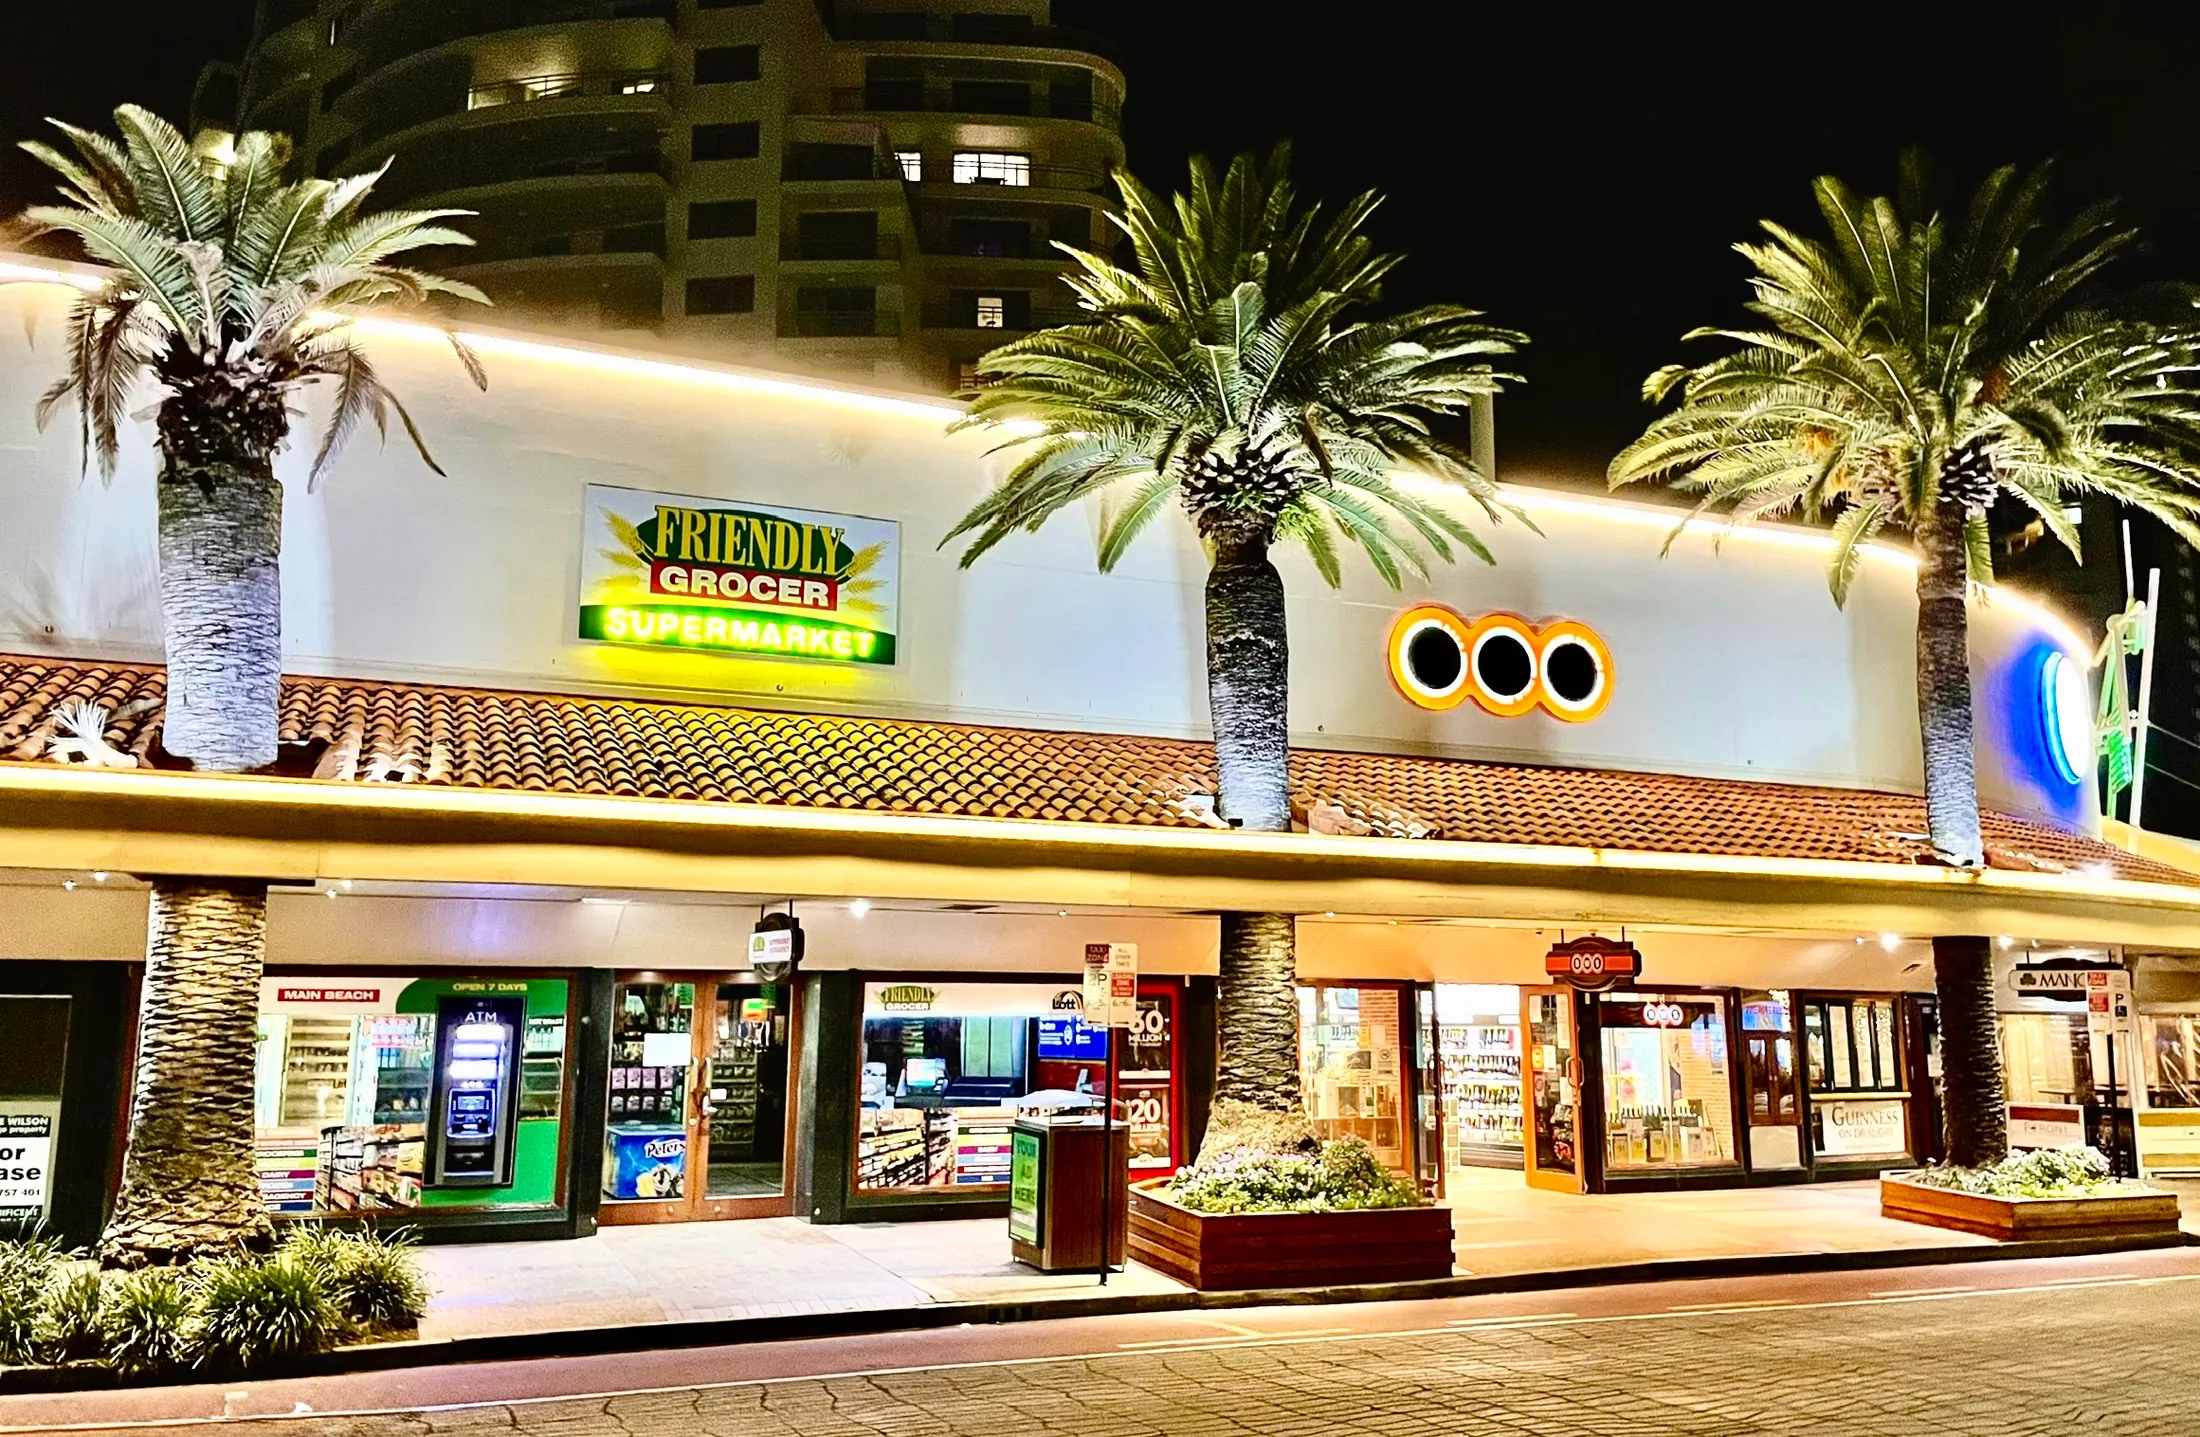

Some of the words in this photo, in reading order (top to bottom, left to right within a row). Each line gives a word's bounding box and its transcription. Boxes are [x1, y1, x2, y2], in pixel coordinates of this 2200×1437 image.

[653, 505, 845, 576] FRIENDLY
[659, 566, 829, 607] GROCER
[605, 608, 875, 658] SUPERMARKET
[453, 983, 485, 991] OPEN
[488, 983, 495, 991] 7
[498, 983, 528, 991] DAYS
[885, 987, 932, 1002] FRIENDLY
[284, 990, 321, 1000] MAIN
[324, 991, 374, 1000] BEACH
[465, 1012, 498, 1022] ATM
[1128, 1033, 1162, 1042] MILLION
[8, 1117, 48, 1126] WILSON
[1832, 1106, 1899, 1126] GUINNESS
[1016, 1138, 1037, 1157] YOUR
